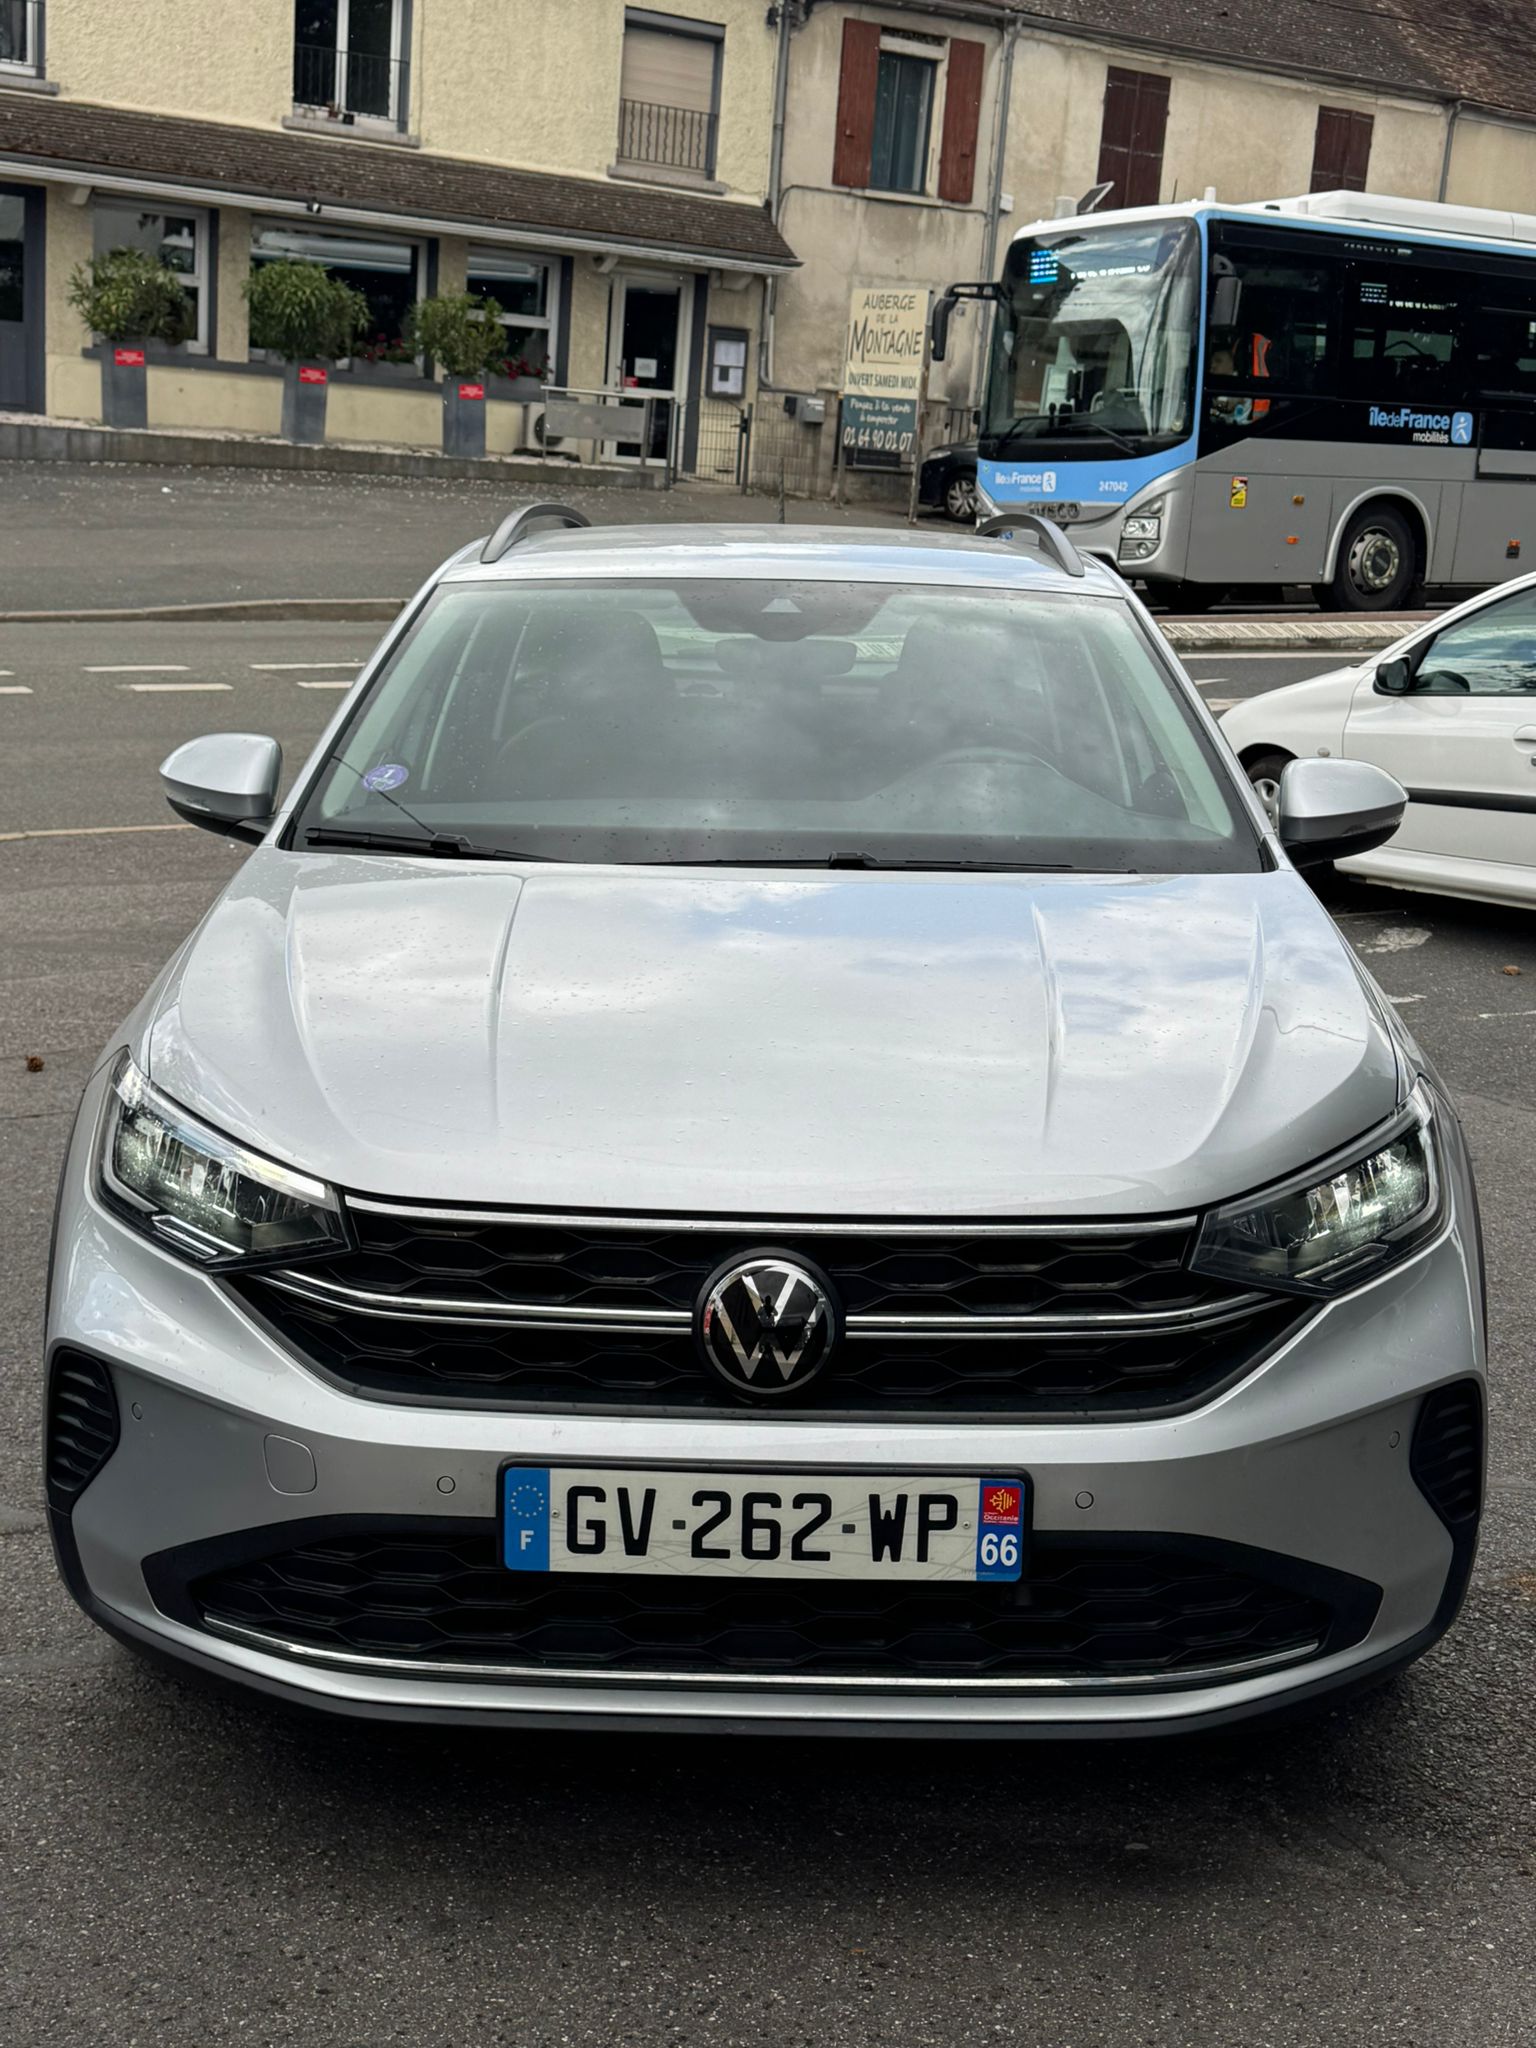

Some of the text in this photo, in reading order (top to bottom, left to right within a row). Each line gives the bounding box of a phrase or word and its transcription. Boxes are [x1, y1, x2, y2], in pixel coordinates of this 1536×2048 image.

[863, 294, 916, 311] AUBERGE
[876, 314, 898, 324] DE LA
[850, 316, 922, 363] MONTAGNE
[843, 426, 856, 446] 01
[885, 430, 897, 450] 01
[899, 431, 913, 451] 07
[1412, 431, 1449, 444] mobilités
[983, 1514, 1019, 1522] Occitanie
[520, 1529, 535, 1551] F
[981, 1533, 1018, 1567] 66
